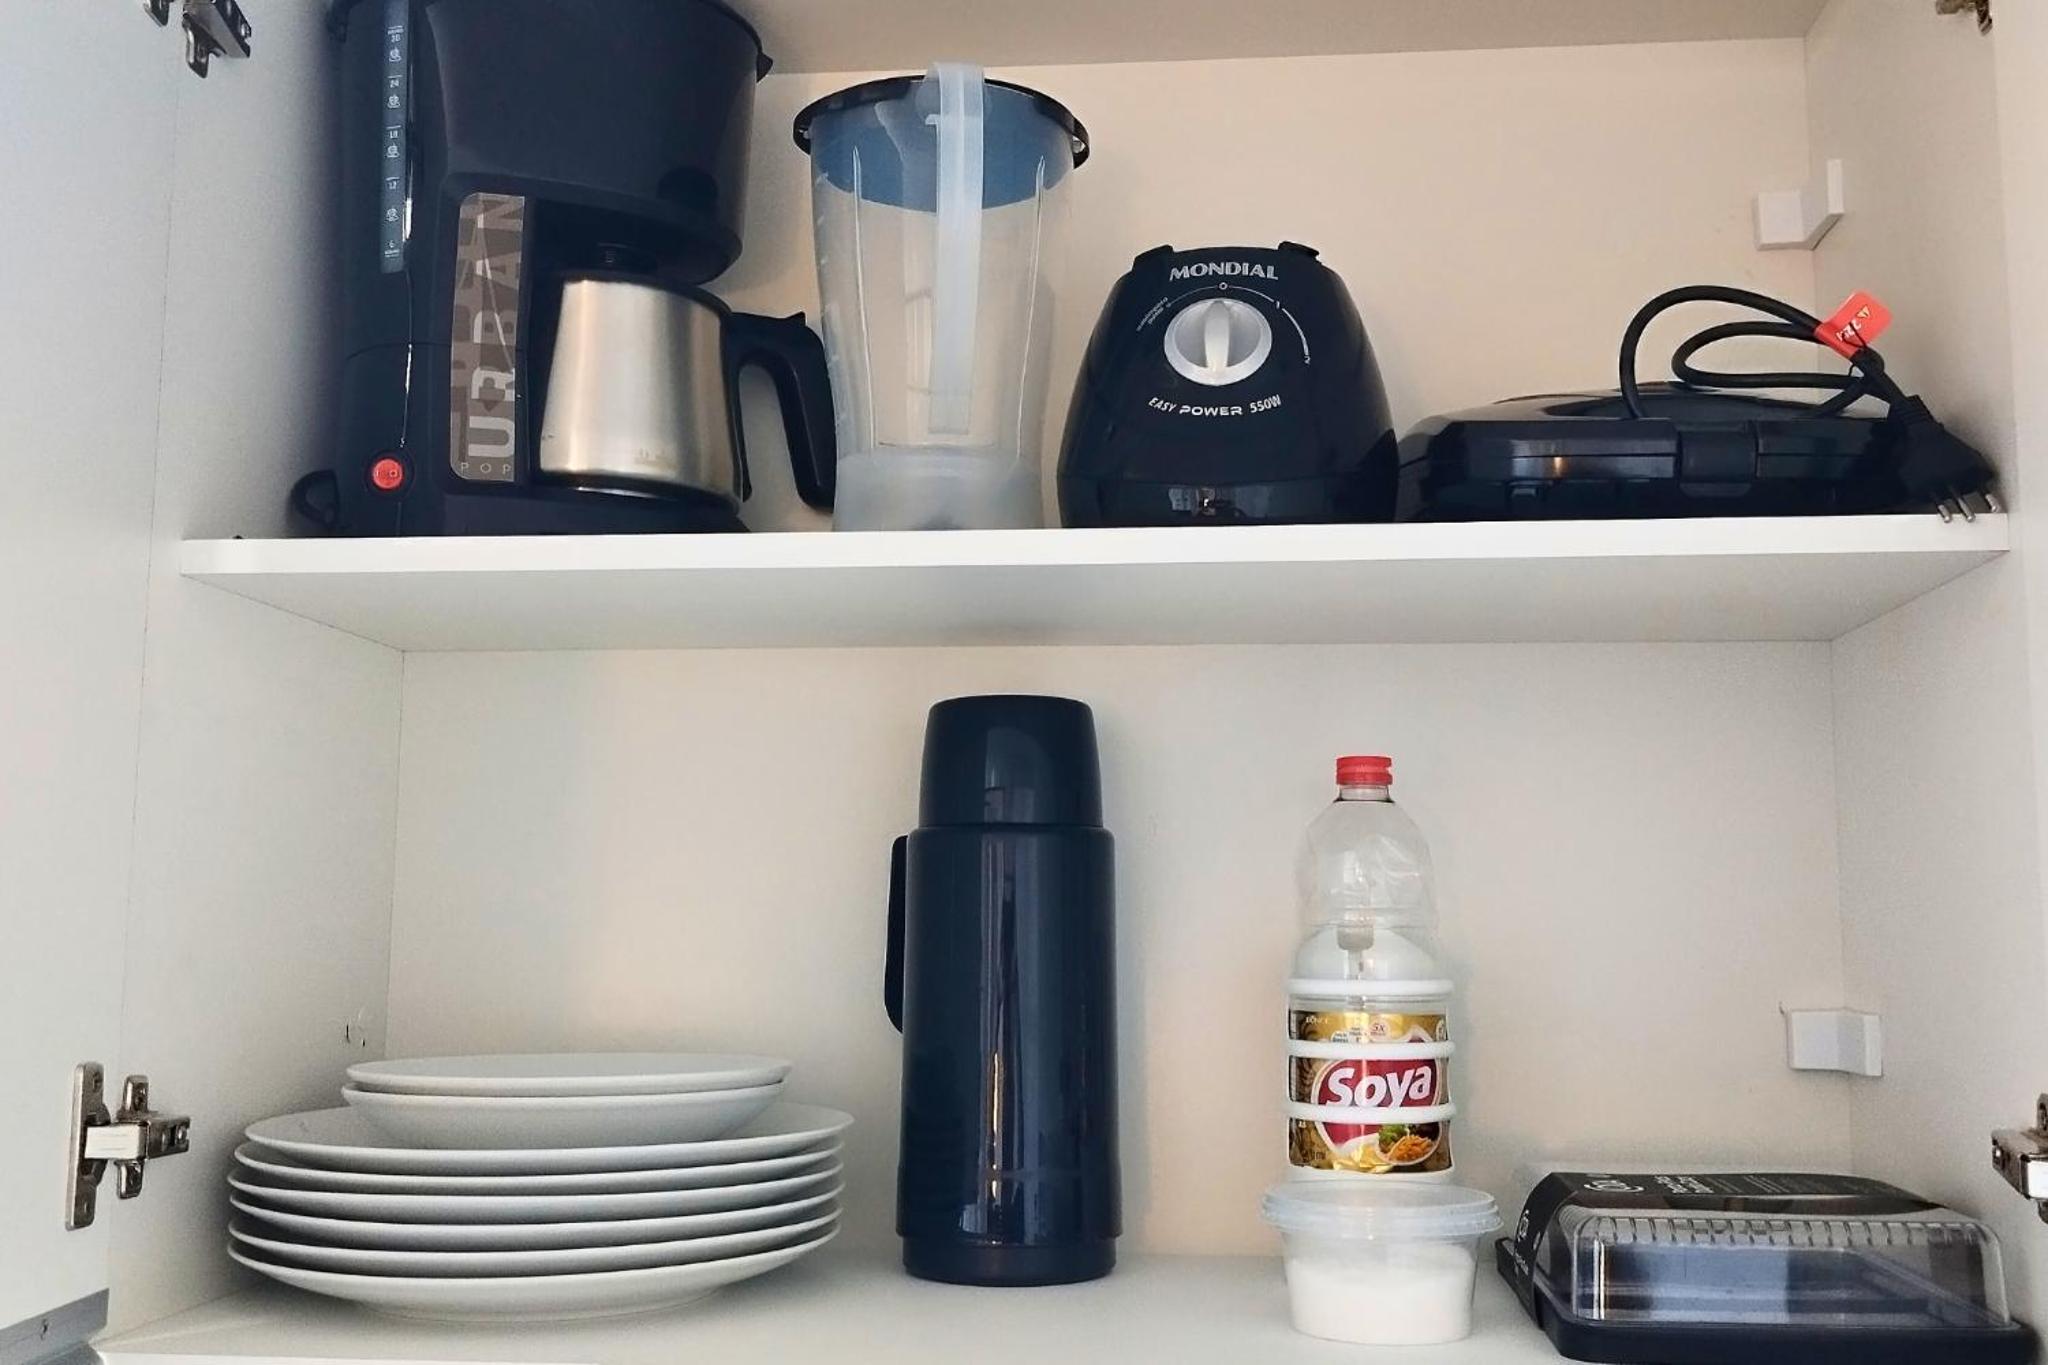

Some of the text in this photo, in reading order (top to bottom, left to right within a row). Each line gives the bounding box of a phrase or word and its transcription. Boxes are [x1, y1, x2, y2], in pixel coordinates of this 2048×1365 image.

[1169, 262, 1279, 281] MONDIAL
[468, 197, 524, 457] URBAN
[1148, 394, 1282, 417] EASY POWER 550W
[1326, 1066, 1432, 1108] Soya
